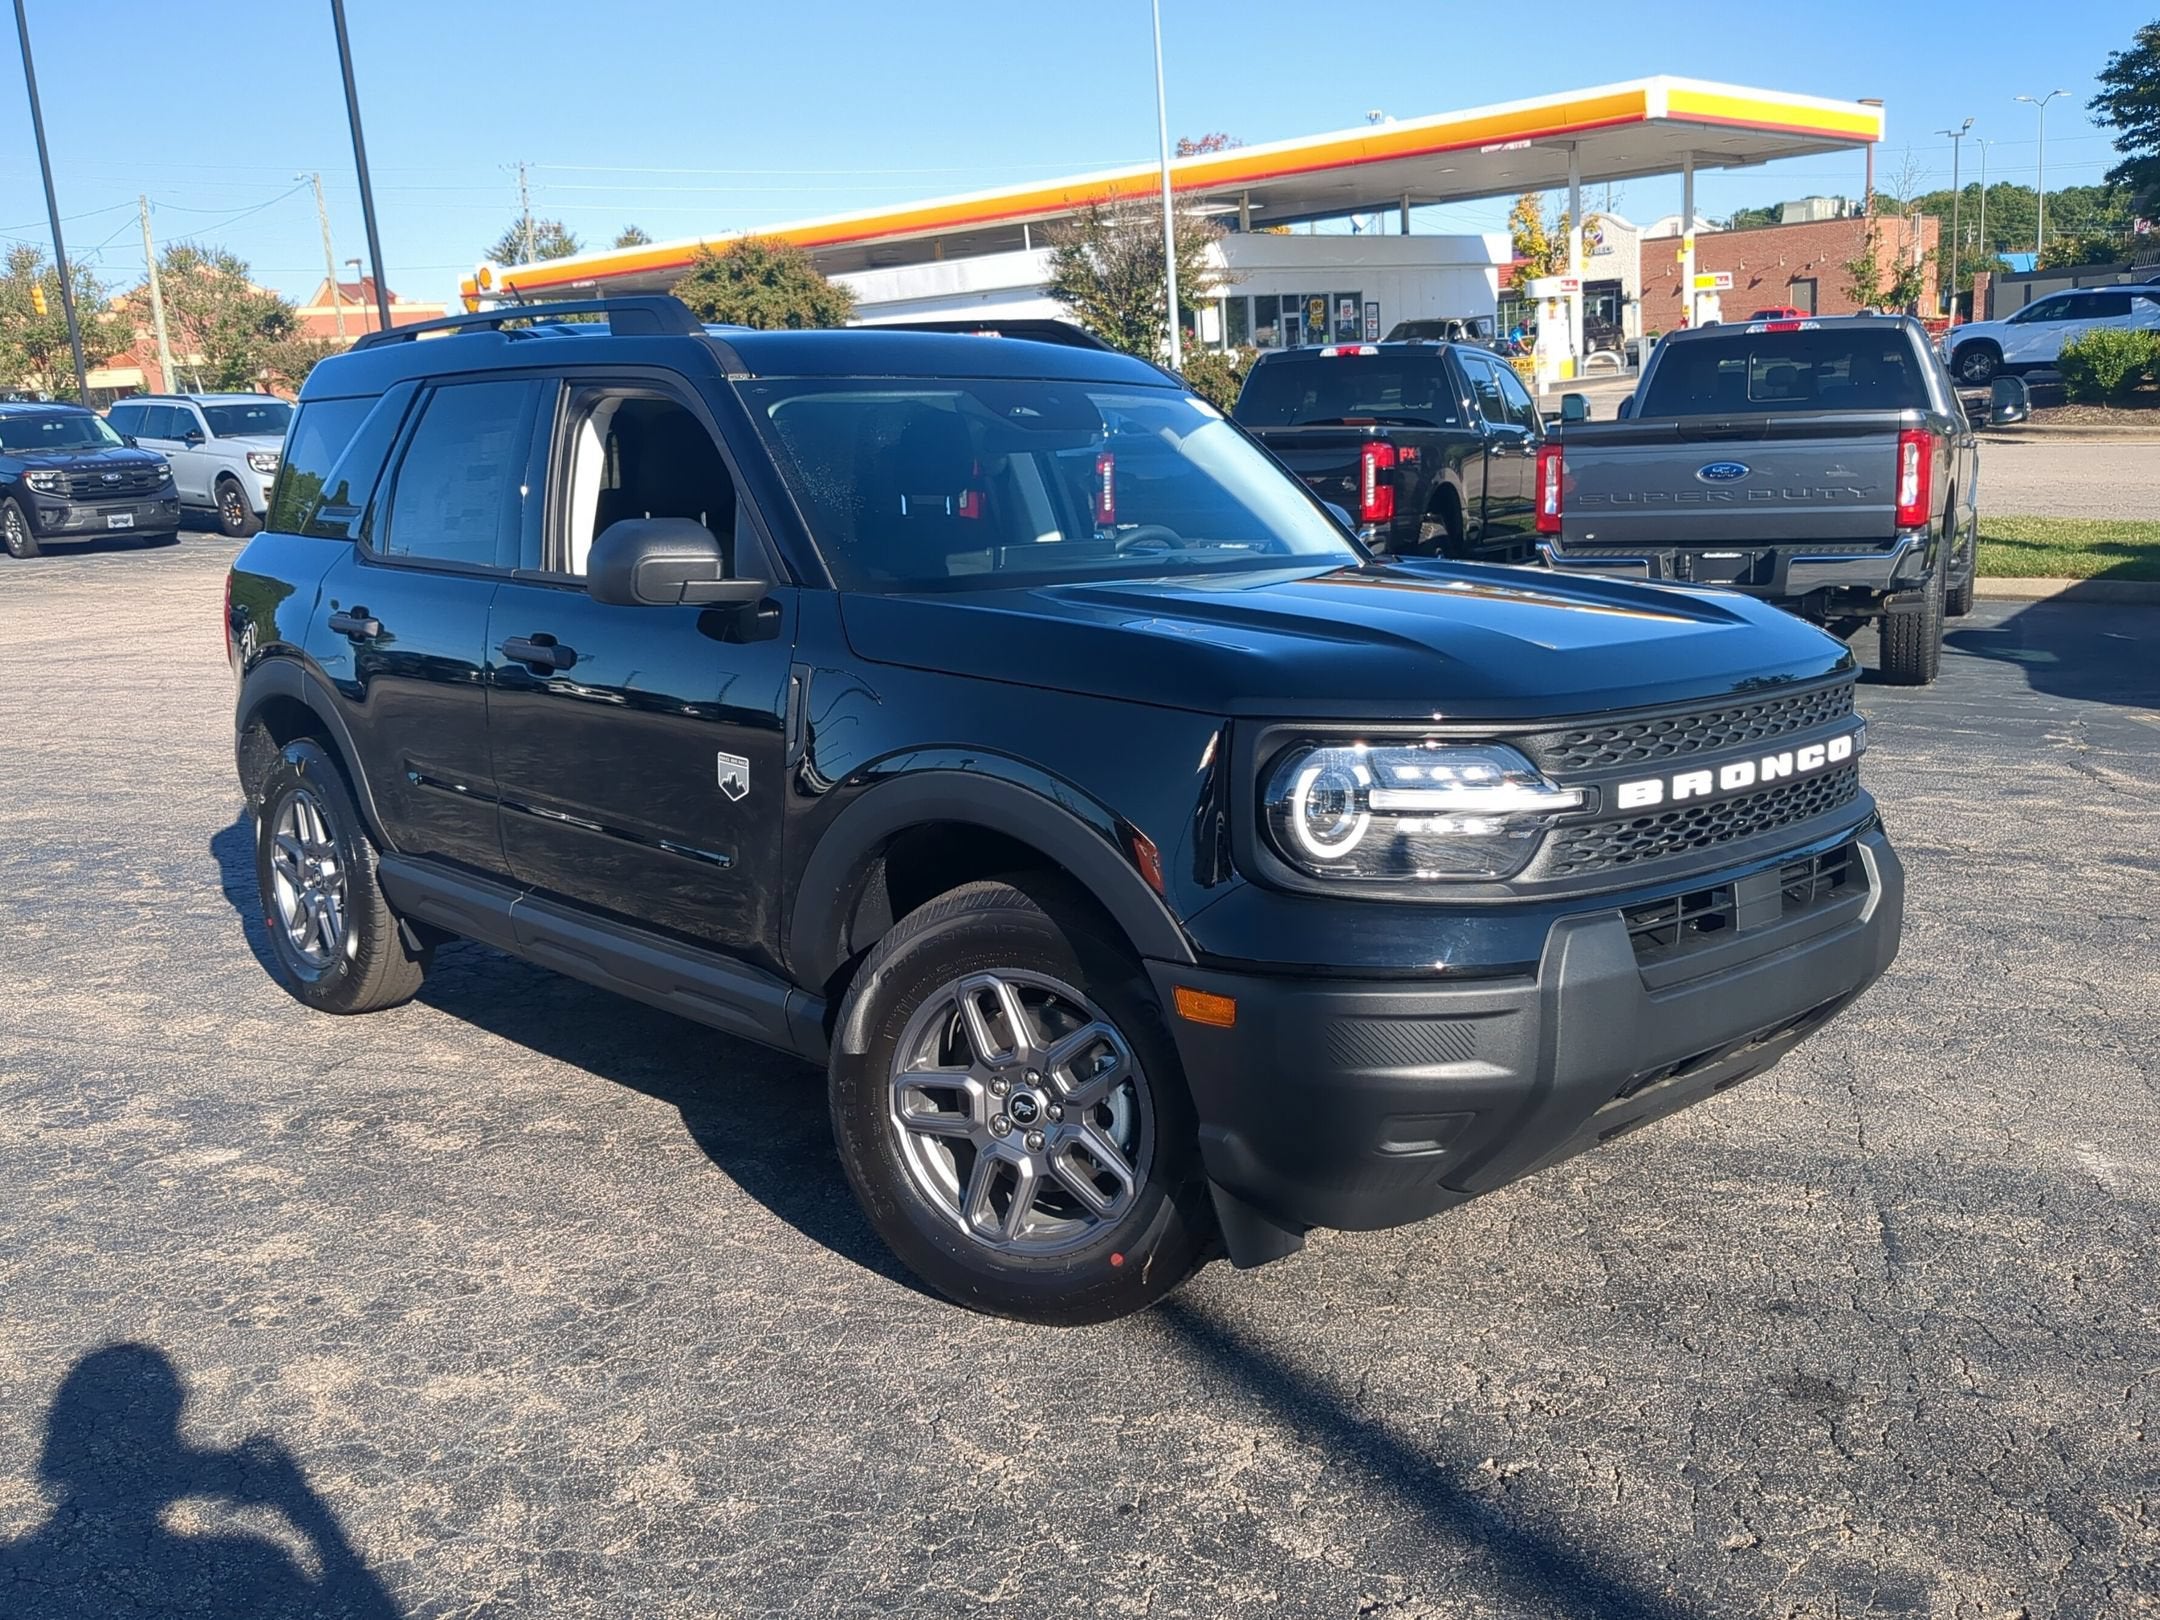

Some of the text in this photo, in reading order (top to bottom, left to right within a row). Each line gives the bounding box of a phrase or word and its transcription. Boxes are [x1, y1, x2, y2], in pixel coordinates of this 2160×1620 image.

[1579, 486, 1877, 505] SUPER DUTY
[1617, 735, 1852, 810] BRONCO
